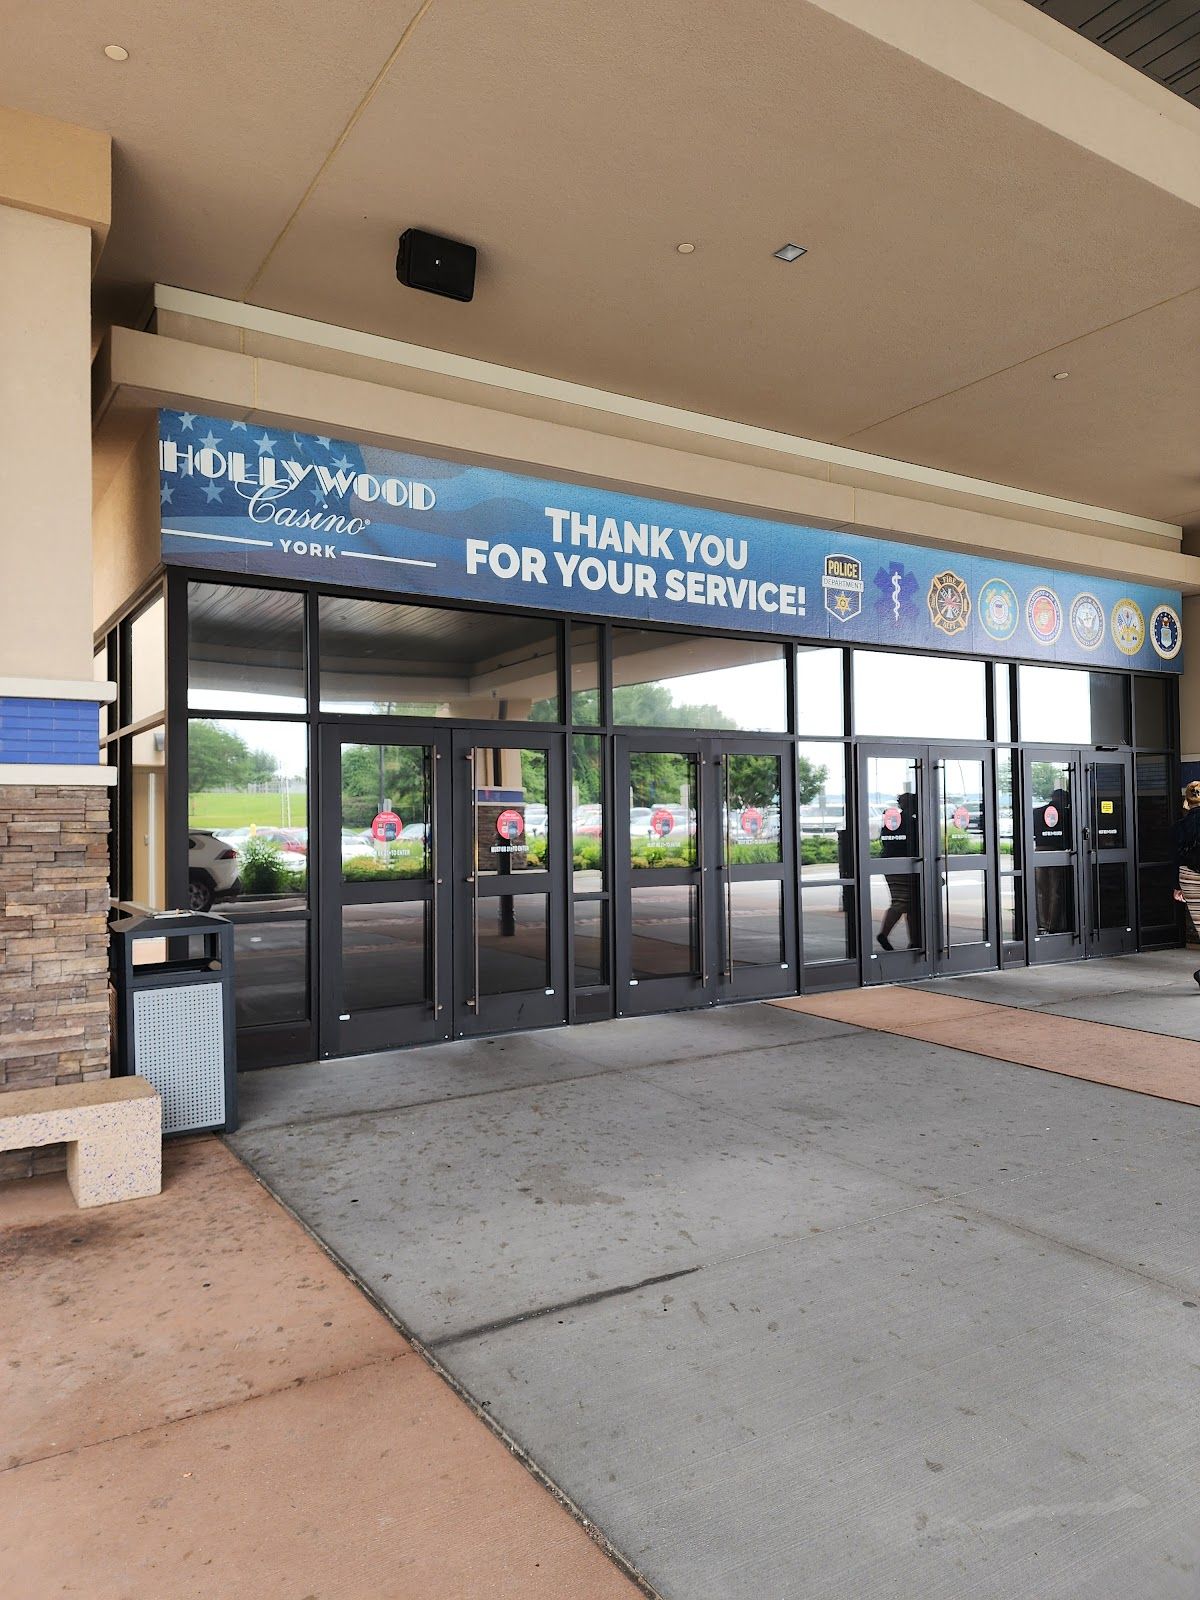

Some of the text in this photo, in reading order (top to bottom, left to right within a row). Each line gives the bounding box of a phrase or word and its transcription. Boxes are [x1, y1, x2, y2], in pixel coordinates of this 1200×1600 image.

[159, 440, 436, 511] HOLLYWOOD
[279, 538, 337, 559] YORK
[544, 506, 748, 570] THANK YOU
[466, 538, 806, 616] FOR YOUR SERVICE!
[823, 577, 863, 590] DEPARTMENT
[828, 559, 858, 578] POLICE
